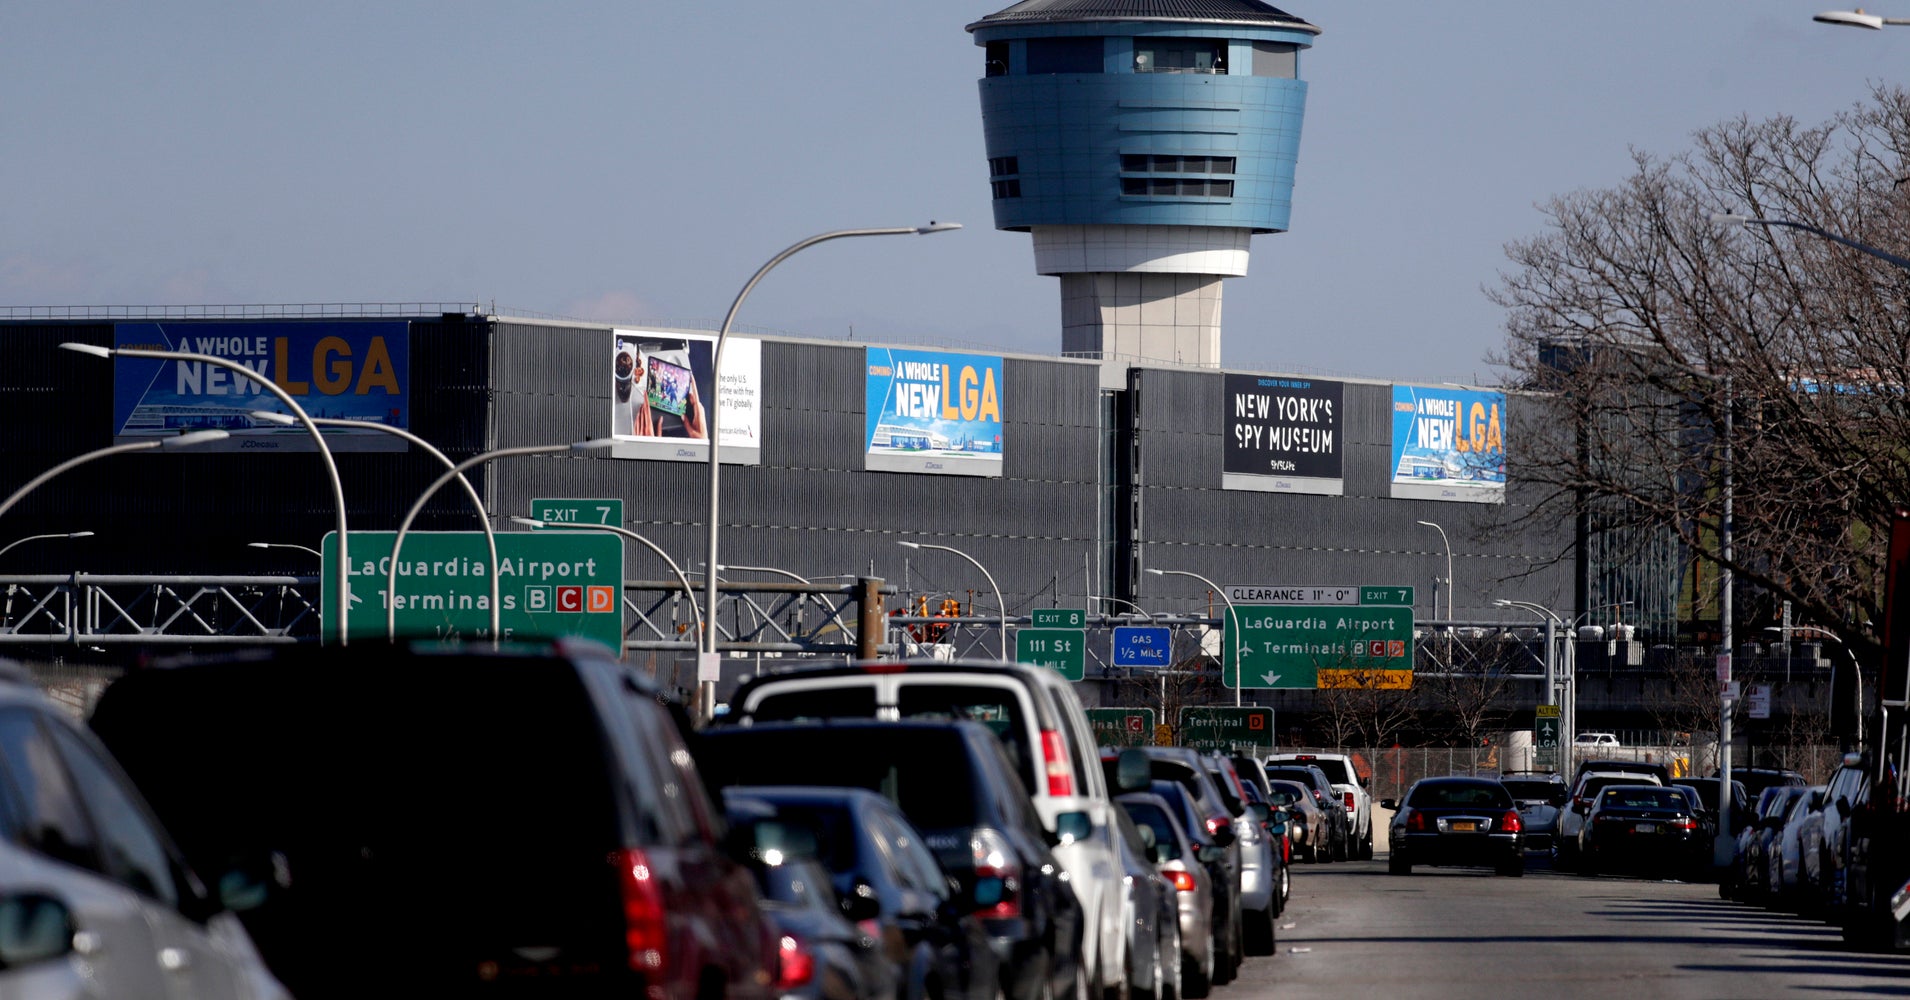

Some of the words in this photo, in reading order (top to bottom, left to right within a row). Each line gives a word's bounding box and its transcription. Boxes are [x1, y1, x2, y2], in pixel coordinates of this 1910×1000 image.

[177, 336, 191, 355] A
[195, 336, 268, 355] WHOLE
[274, 335, 401, 397] LGA
[896, 361, 904, 379] A
[905, 362, 940, 381] WHOLE
[176, 359, 269, 396] NEW
[895, 382, 940, 418] NEW
[941, 364, 1000, 423] LGA
[1236, 393, 1270, 419] NEW
[1276, 396, 1333, 424] YORK'S
[1418, 398, 1425, 415] A
[1425, 398, 1454, 417] WHOLE
[1417, 417, 1454, 450] NEW
[1455, 401, 1503, 455] LGA
[1235, 423, 1263, 450] SPY
[1269, 426, 1333, 454] MUSEUM
[543, 508, 578, 522] EXIT
[596, 505, 612, 525] 7
[498, 556, 597, 581] Airport
[377, 589, 516, 610] Terminas
[530, 589, 546, 609] B
[561, 589, 577, 610] C
[592, 589, 609, 609] D
[1233, 589, 1304, 601] CLEARANCE
[1367, 592, 1388, 600] EXIT
[1398, 590, 1407, 602] 7
[1038, 614, 1060, 623] EXIT
[1069, 613, 1079, 625] 8
[1245, 617, 1327, 630] LaGuardia
[1336, 617, 1395, 631] Airport
[475, 627, 514, 642] ME
[1131, 635, 1152, 644] GAS
[1029, 640, 1046, 652] 111
[1054, 640, 1072, 653] St
[1121, 647, 1135, 659] 1/2
[1140, 649, 1163, 658] MILE
[1264, 641, 1345, 654] Terminals
[1372, 643, 1382, 654] C
[1044, 660, 1066, 669] MILE
[1374, 674, 1406, 684] ONLY
[1131, 719, 1140, 731] C
[1189, 717, 1242, 728] Terminal
[1251, 717, 1261, 728] D
[1538, 739, 1557, 747] LGA
